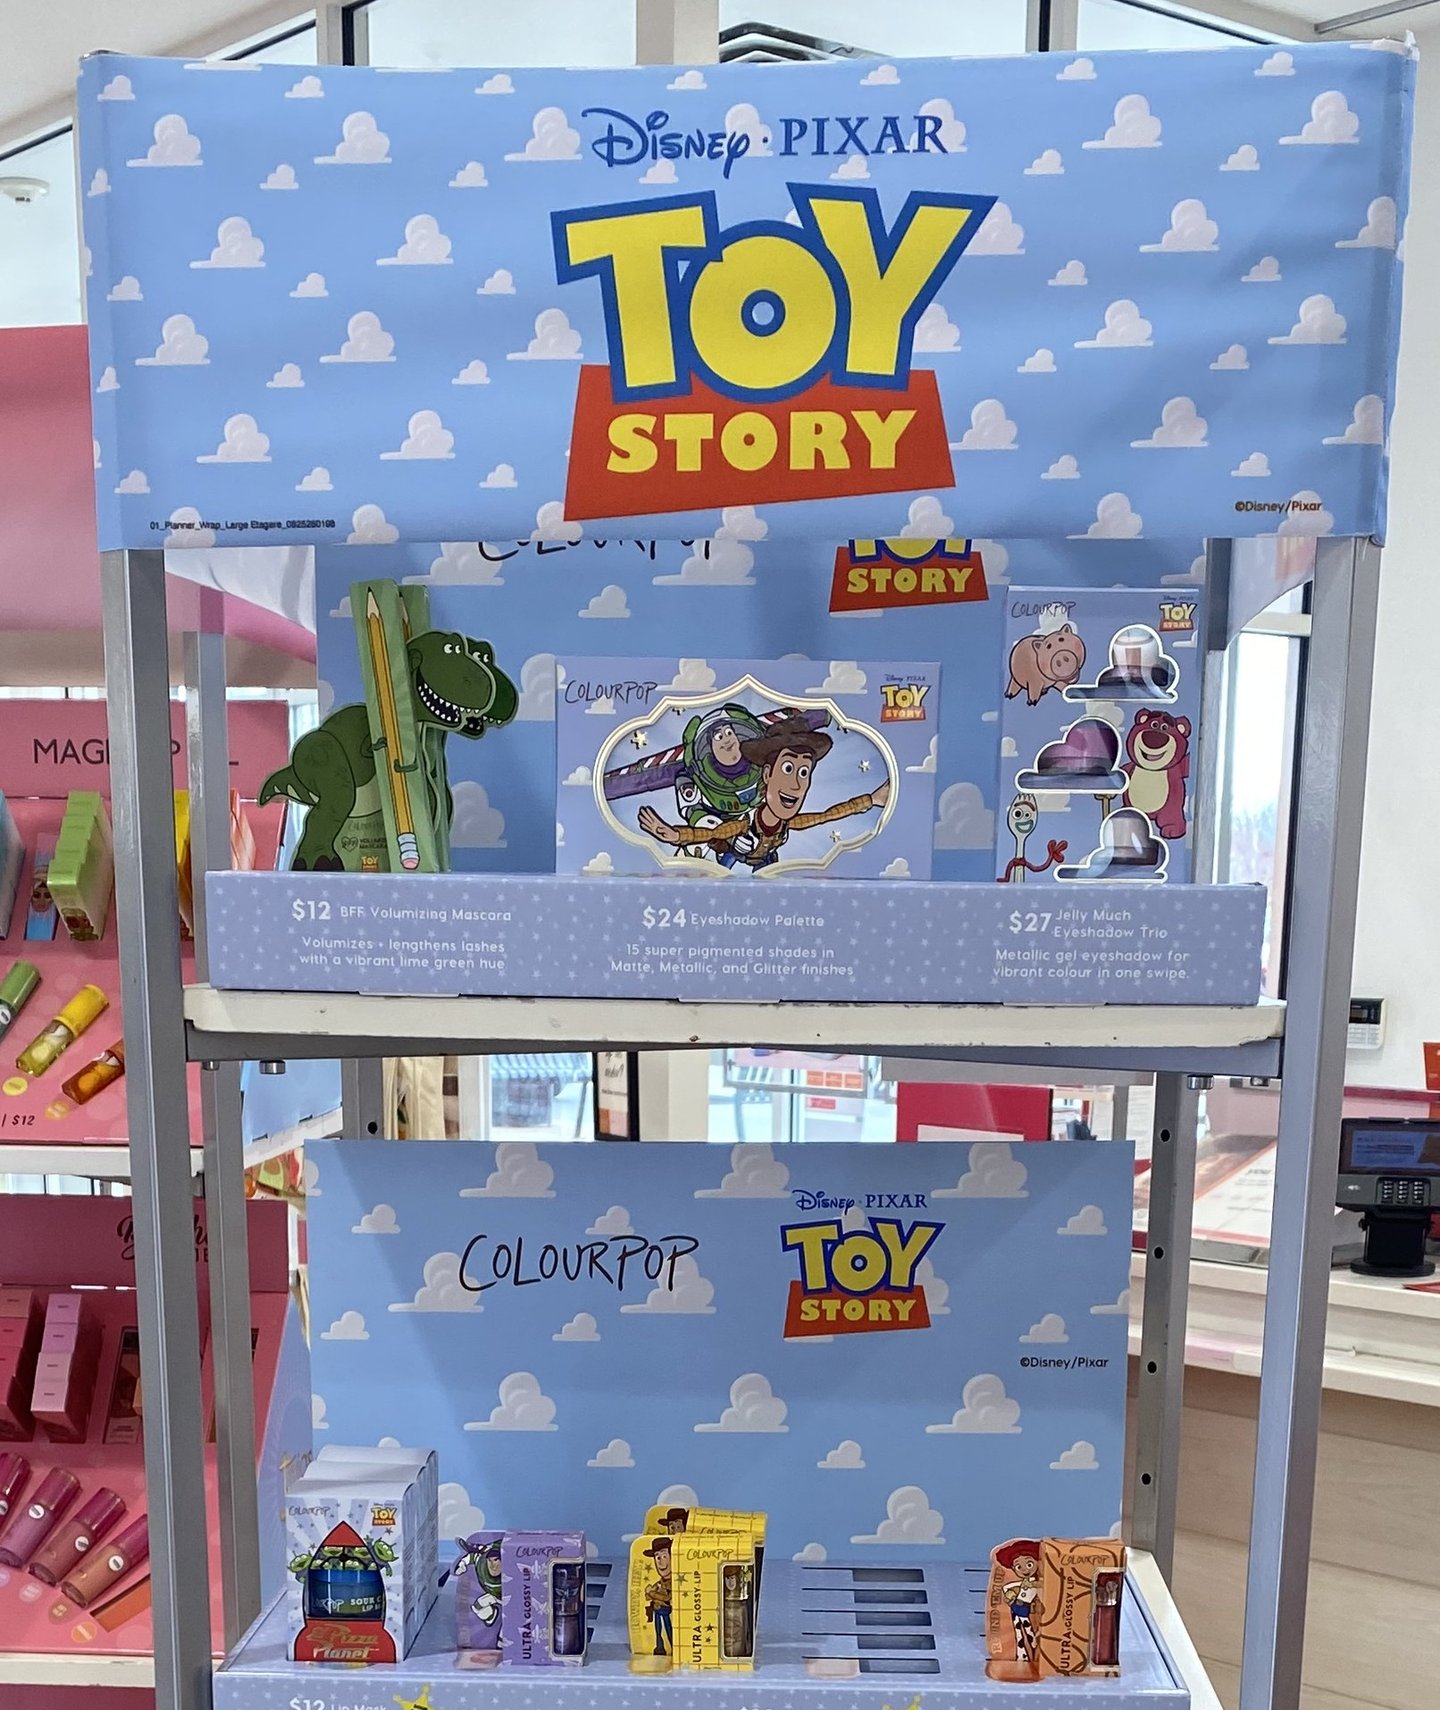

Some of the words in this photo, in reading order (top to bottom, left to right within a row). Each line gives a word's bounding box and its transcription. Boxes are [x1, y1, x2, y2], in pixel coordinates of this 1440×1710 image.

[779, 115, 949, 156] PIXAR
[551, 182, 998, 404] TOY
[607, 409, 918, 473] STORY
[847, 567, 974, 594] STORY
[1011, 601, 1077, 618] COLOURPOP
[1159, 602, 1197, 621] TOY
[564, 680, 658, 704] COLOURPOP
[880, 683, 931, 708] TOY
[885, 709, 922, 718] STORY
[292, 898, 331, 921] $12
[340, 905, 364, 918] BFF
[370, 907, 447, 923] Volumizing
[452, 908, 512, 922] Mascara
[642, 905, 687, 929] $24
[691, 912, 770, 929] Eyeshadow
[775, 914, 825, 928] Palette
[1009, 910, 1052, 934] $27
[1055, 909, 1088, 923] Jelly
[1093, 909, 1132, 921] Much
[1053, 926, 1134, 940] Eyeshadow
[1140, 924, 1168, 939] Trio
[302, 937, 374, 950] Volumizes
[389, 938, 456, 955] lengthens
[461, 940, 505, 953] lashes
[626, 944, 640, 956] 15
[645, 946, 683, 960] super
[688, 946, 764, 961] pigmented
[768, 946, 817, 959] shades
[821, 947, 835, 959] in
[995, 949, 1050, 961] Metallic
[1055, 949, 1077, 963] gel
[1081, 949, 1162, 963] eyeshadow
[1167, 950, 1189, 962] for
[300, 953, 327, 966] with
[333, 956, 341, 966] a
[346, 954, 395, 967] vibrant
[400, 956, 429, 968] lime
[434, 958, 475, 971] green
[479, 957, 505, 970] hue
[610, 960, 654, 974] Matte,
[659, 961, 718, 976] Metallic,
[722, 962, 749, 974] and
[753, 962, 797, 976] Glitter
[801, 963, 854, 976] finishes
[993, 966, 1042, 978] vibrant
[1048, 966, 1092, 978] colour
[1097, 966, 1110, 979] in
[1115, 968, 1142, 979] one
[1146, 967, 1190, 981] swipe.
[11, 1115, 36, 1126] $12
[865, 1193, 928, 1209] PIXAR
[459, 1235, 699, 1292] COLOURPOP
[780, 1217, 946, 1296] TOY
[800, 1298, 916, 1321] STORY
[370, 1506, 397, 1518] TOY
[686, 1549, 735, 1561] COLOURPOP
[1060, 1554, 1111, 1566] COLOURPOP
[523, 1567, 532, 1582] LIP
[693, 1570, 701, 1588] LIP
[1067, 1576, 1075, 1590] LIP
[523, 1584, 532, 1619] GLOSSY
[693, 1597, 702, 1622] GLOSSY
[1064, 1592, 1074, 1628] GLOSSY
[523, 1622, 532, 1660] ULTRA
[692, 1625, 702, 1663] ULTRA
[1060, 1631, 1072, 1669] ULTRA
